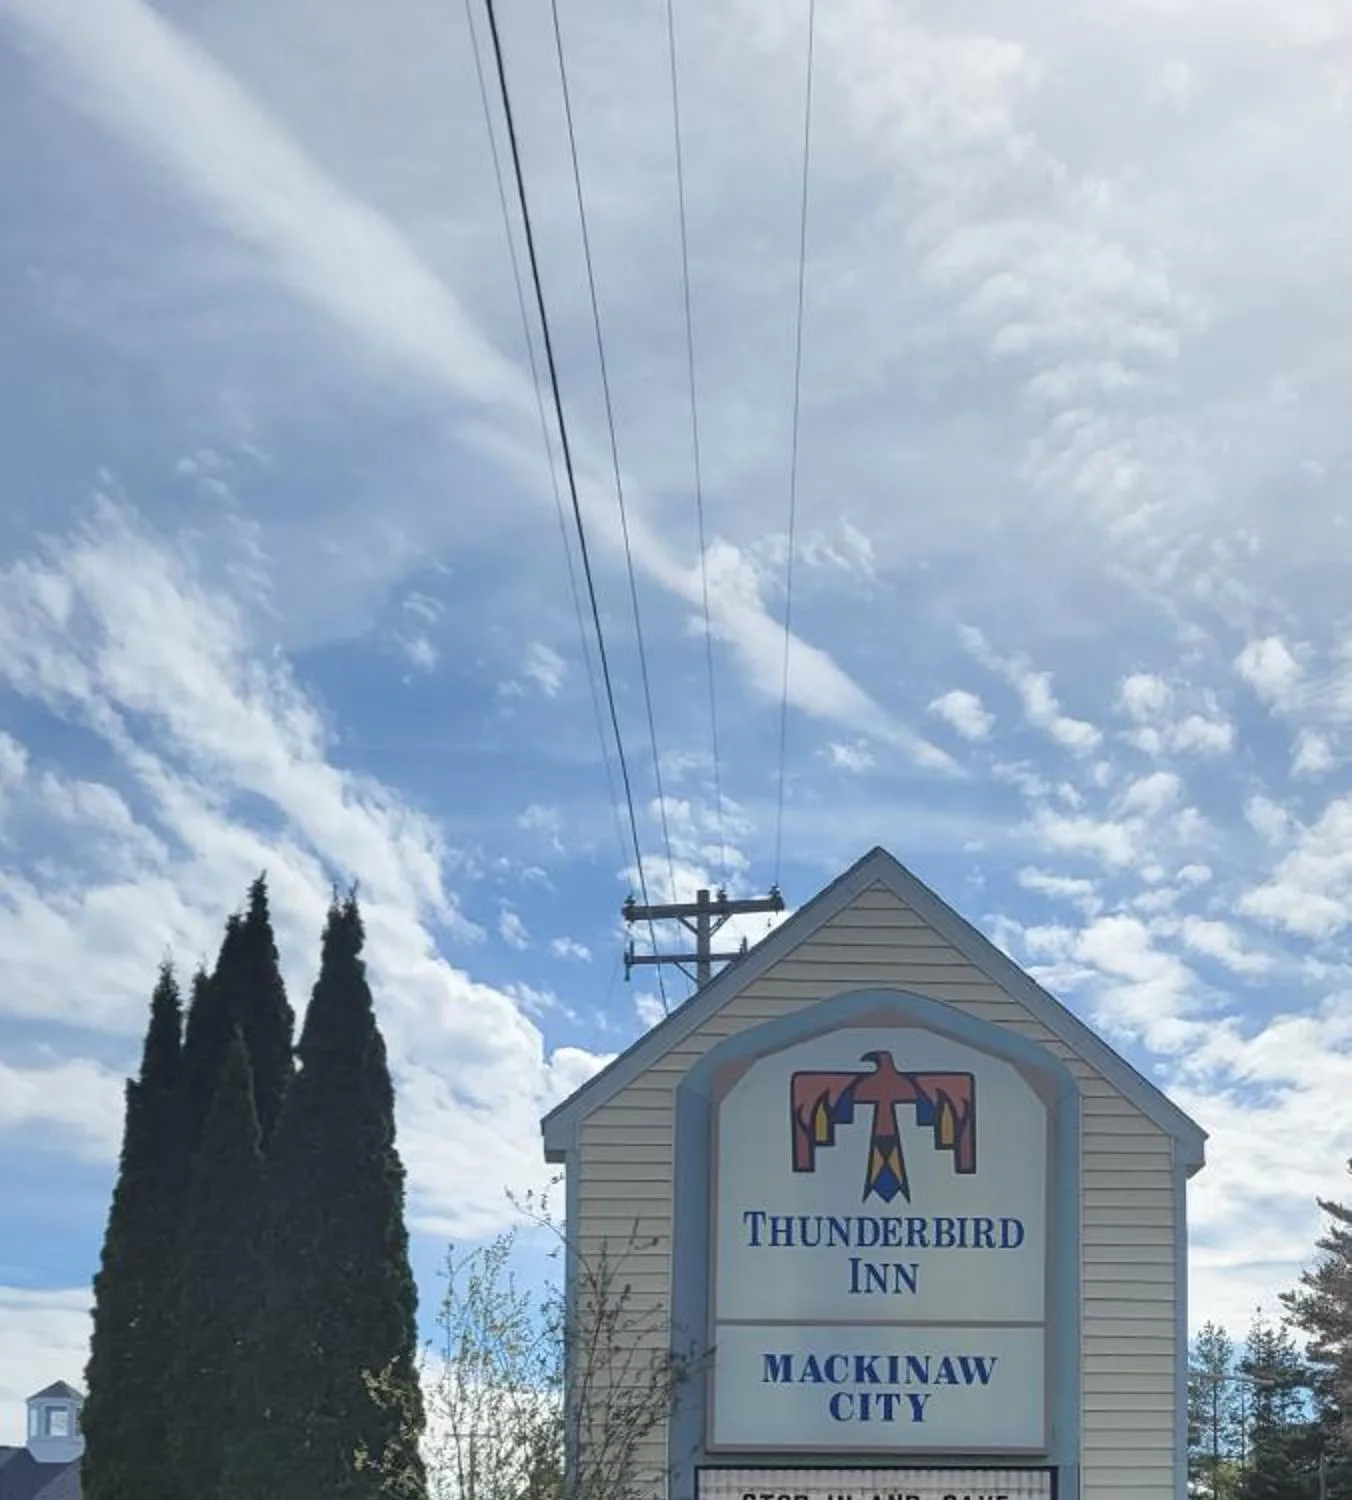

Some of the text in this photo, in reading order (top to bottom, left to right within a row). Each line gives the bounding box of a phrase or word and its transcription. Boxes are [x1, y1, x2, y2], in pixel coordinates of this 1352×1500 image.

[743, 1211, 1025, 1249] THUNDERBIRD
[848, 1258, 919, 1295] INN
[762, 1354, 998, 1385] MACKINAW
[829, 1393, 930, 1422] CITY
